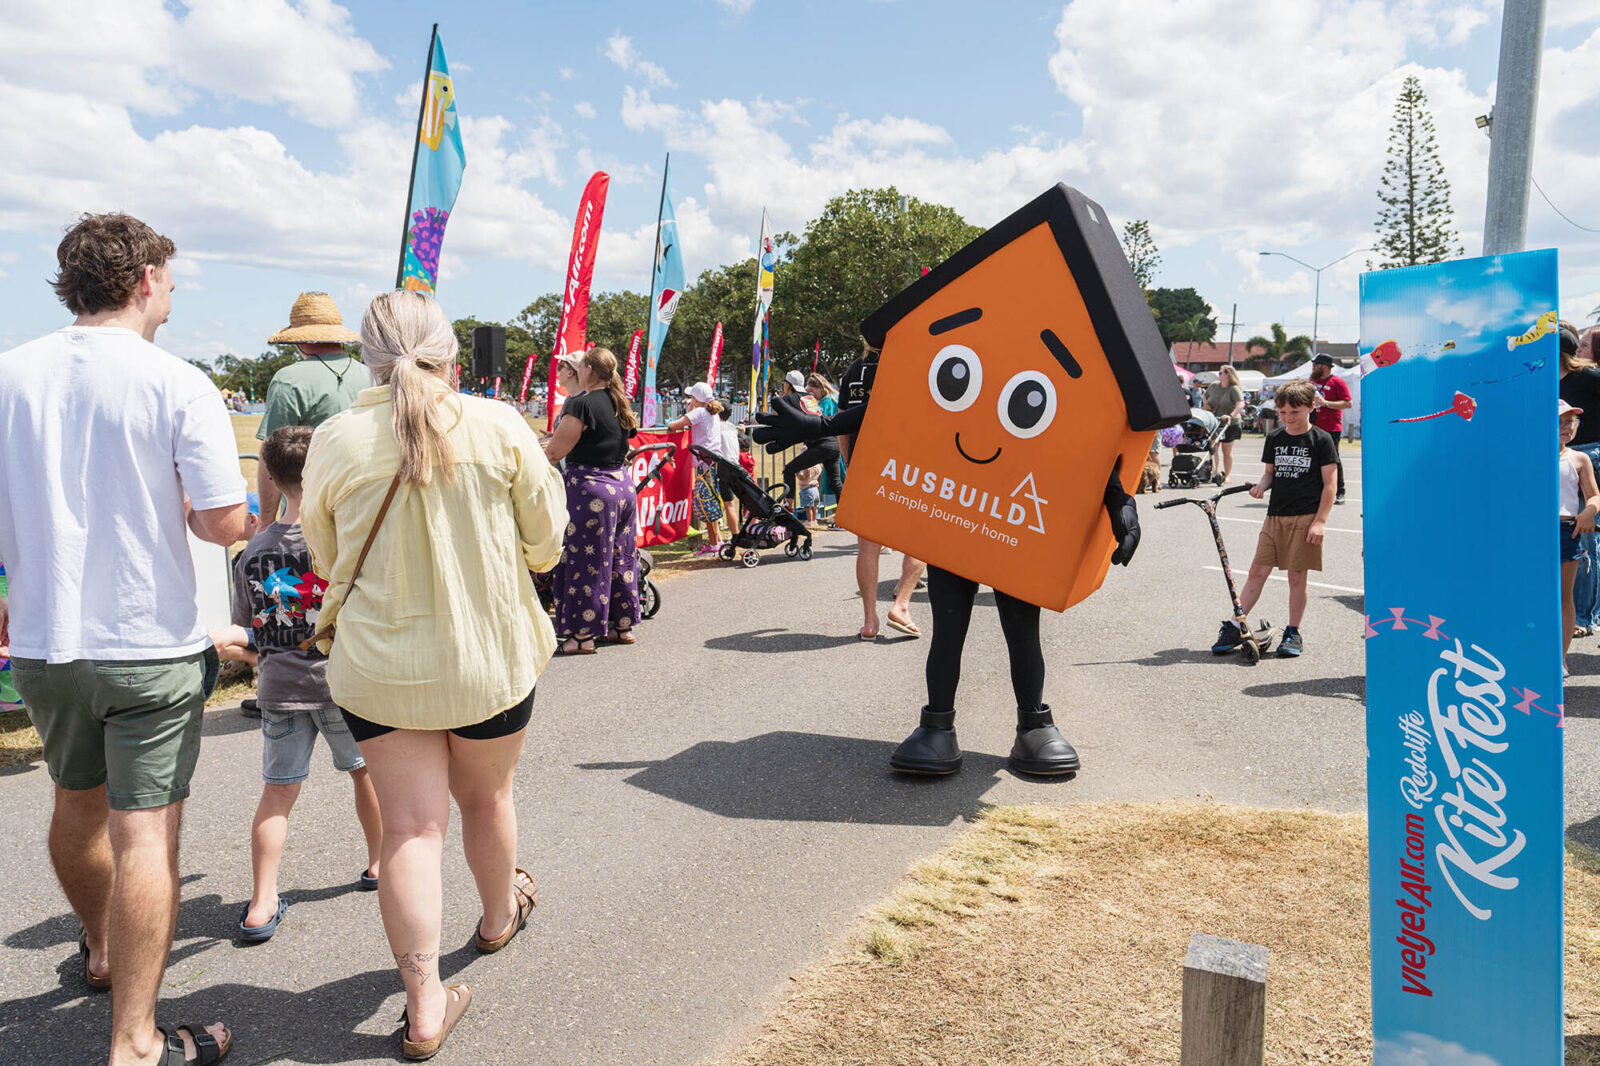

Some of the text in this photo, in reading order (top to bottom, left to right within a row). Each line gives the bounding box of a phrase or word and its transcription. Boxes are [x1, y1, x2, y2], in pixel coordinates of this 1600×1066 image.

[1274, 446, 1310, 456] I'M THE
[876, 485, 1019, 547] A simple journey home
[880, 458, 1027, 526] AUSBUILD
[1400, 709, 1438, 810] Redcliffe
[1428, 637, 1527, 921] Kite Fest
